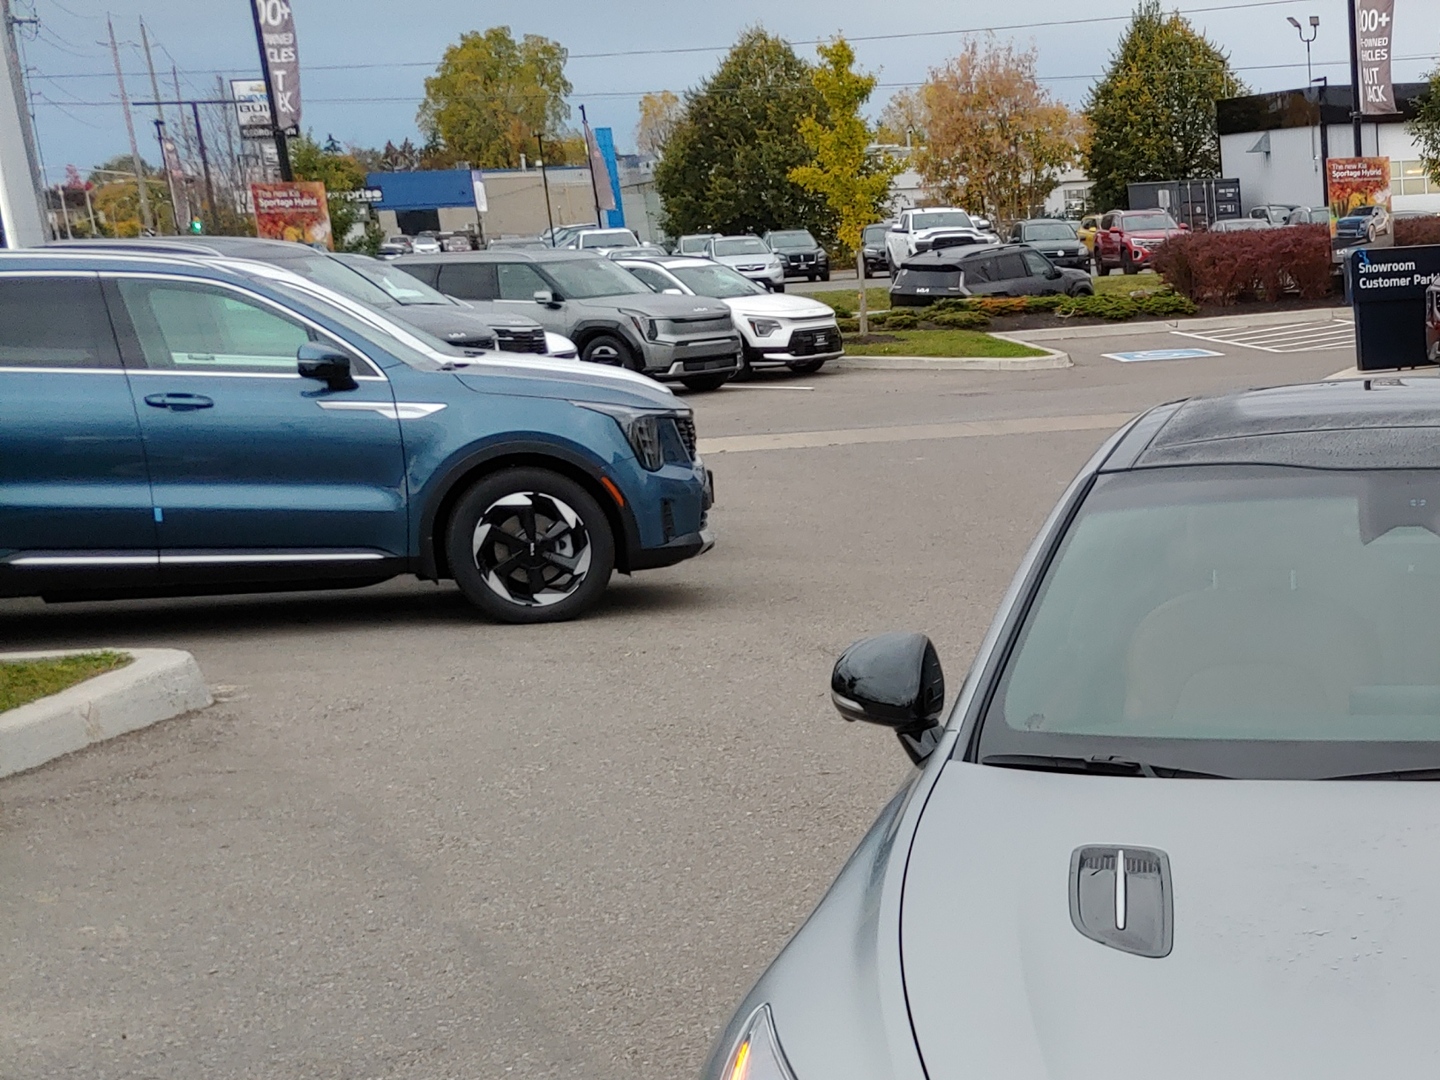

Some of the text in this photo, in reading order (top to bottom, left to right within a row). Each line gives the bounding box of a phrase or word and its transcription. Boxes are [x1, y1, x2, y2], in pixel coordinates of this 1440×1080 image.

[1359, 9, 1390, 32] 00+
[1332, 168, 1382, 178] Sportage Hybrid
[1359, 277, 1411, 289] Customer
